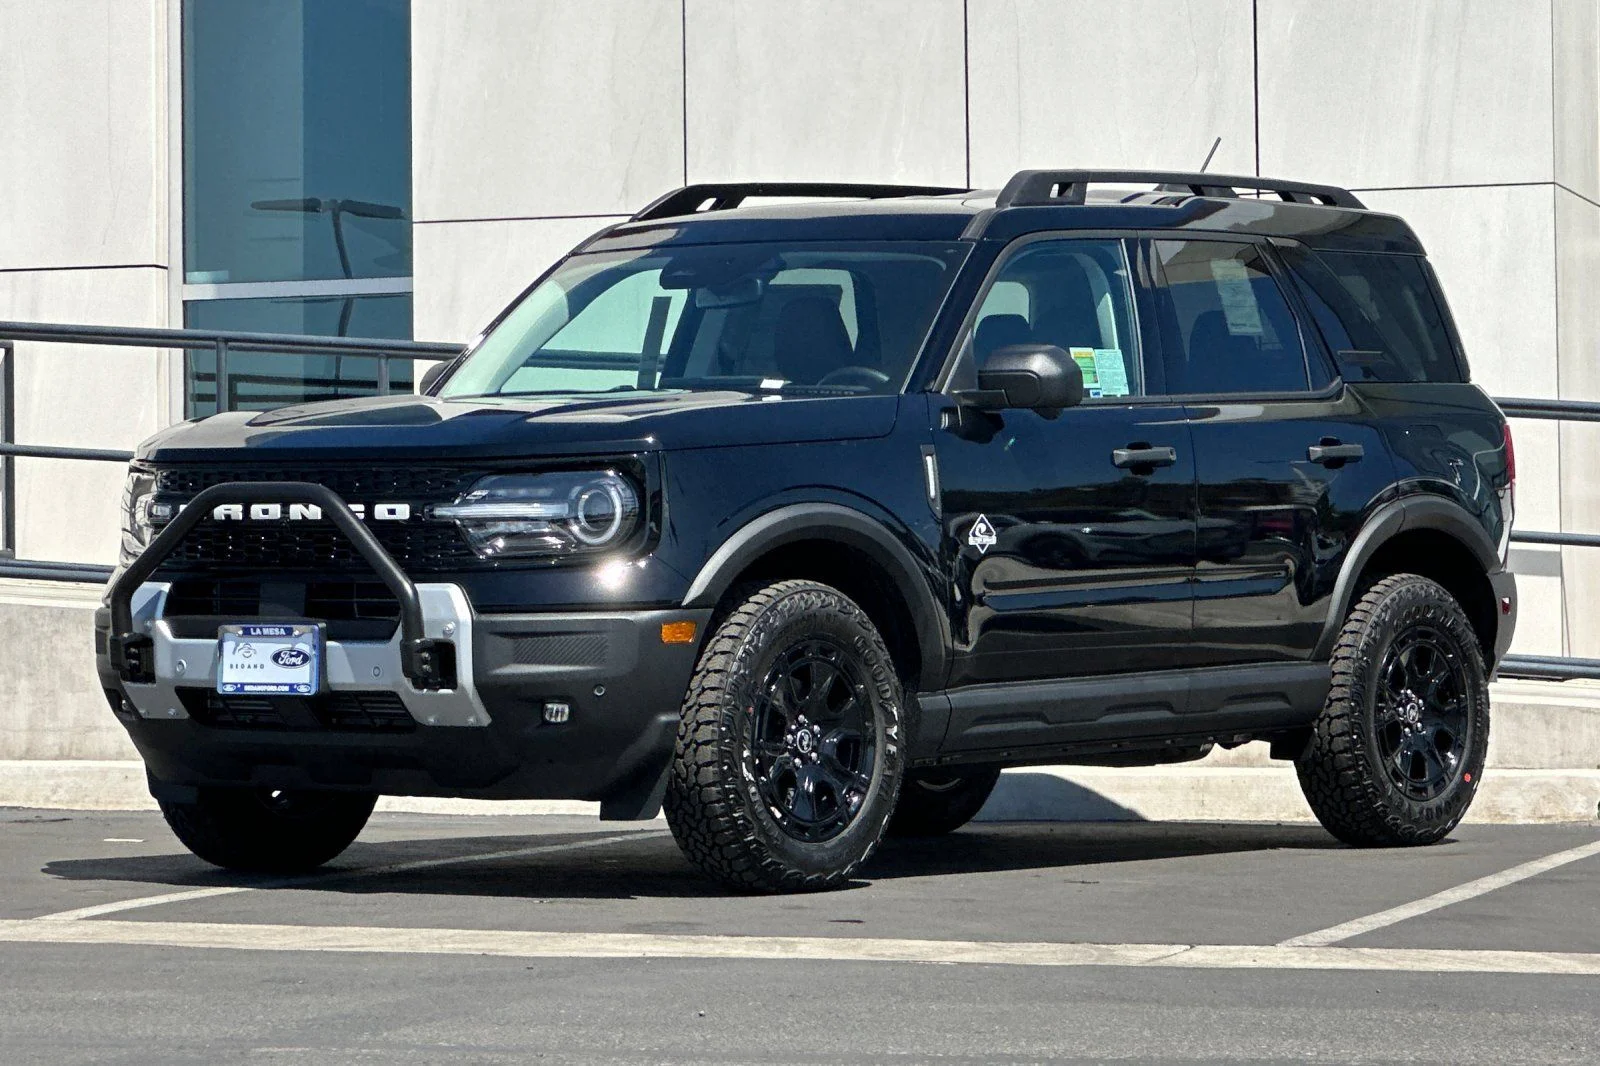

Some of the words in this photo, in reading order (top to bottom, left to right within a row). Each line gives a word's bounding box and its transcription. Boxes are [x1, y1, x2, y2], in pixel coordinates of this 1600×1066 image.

[179, 504, 410, 520] RONO
[250, 627, 262, 636] LA
[263, 627, 286, 636] MESA
